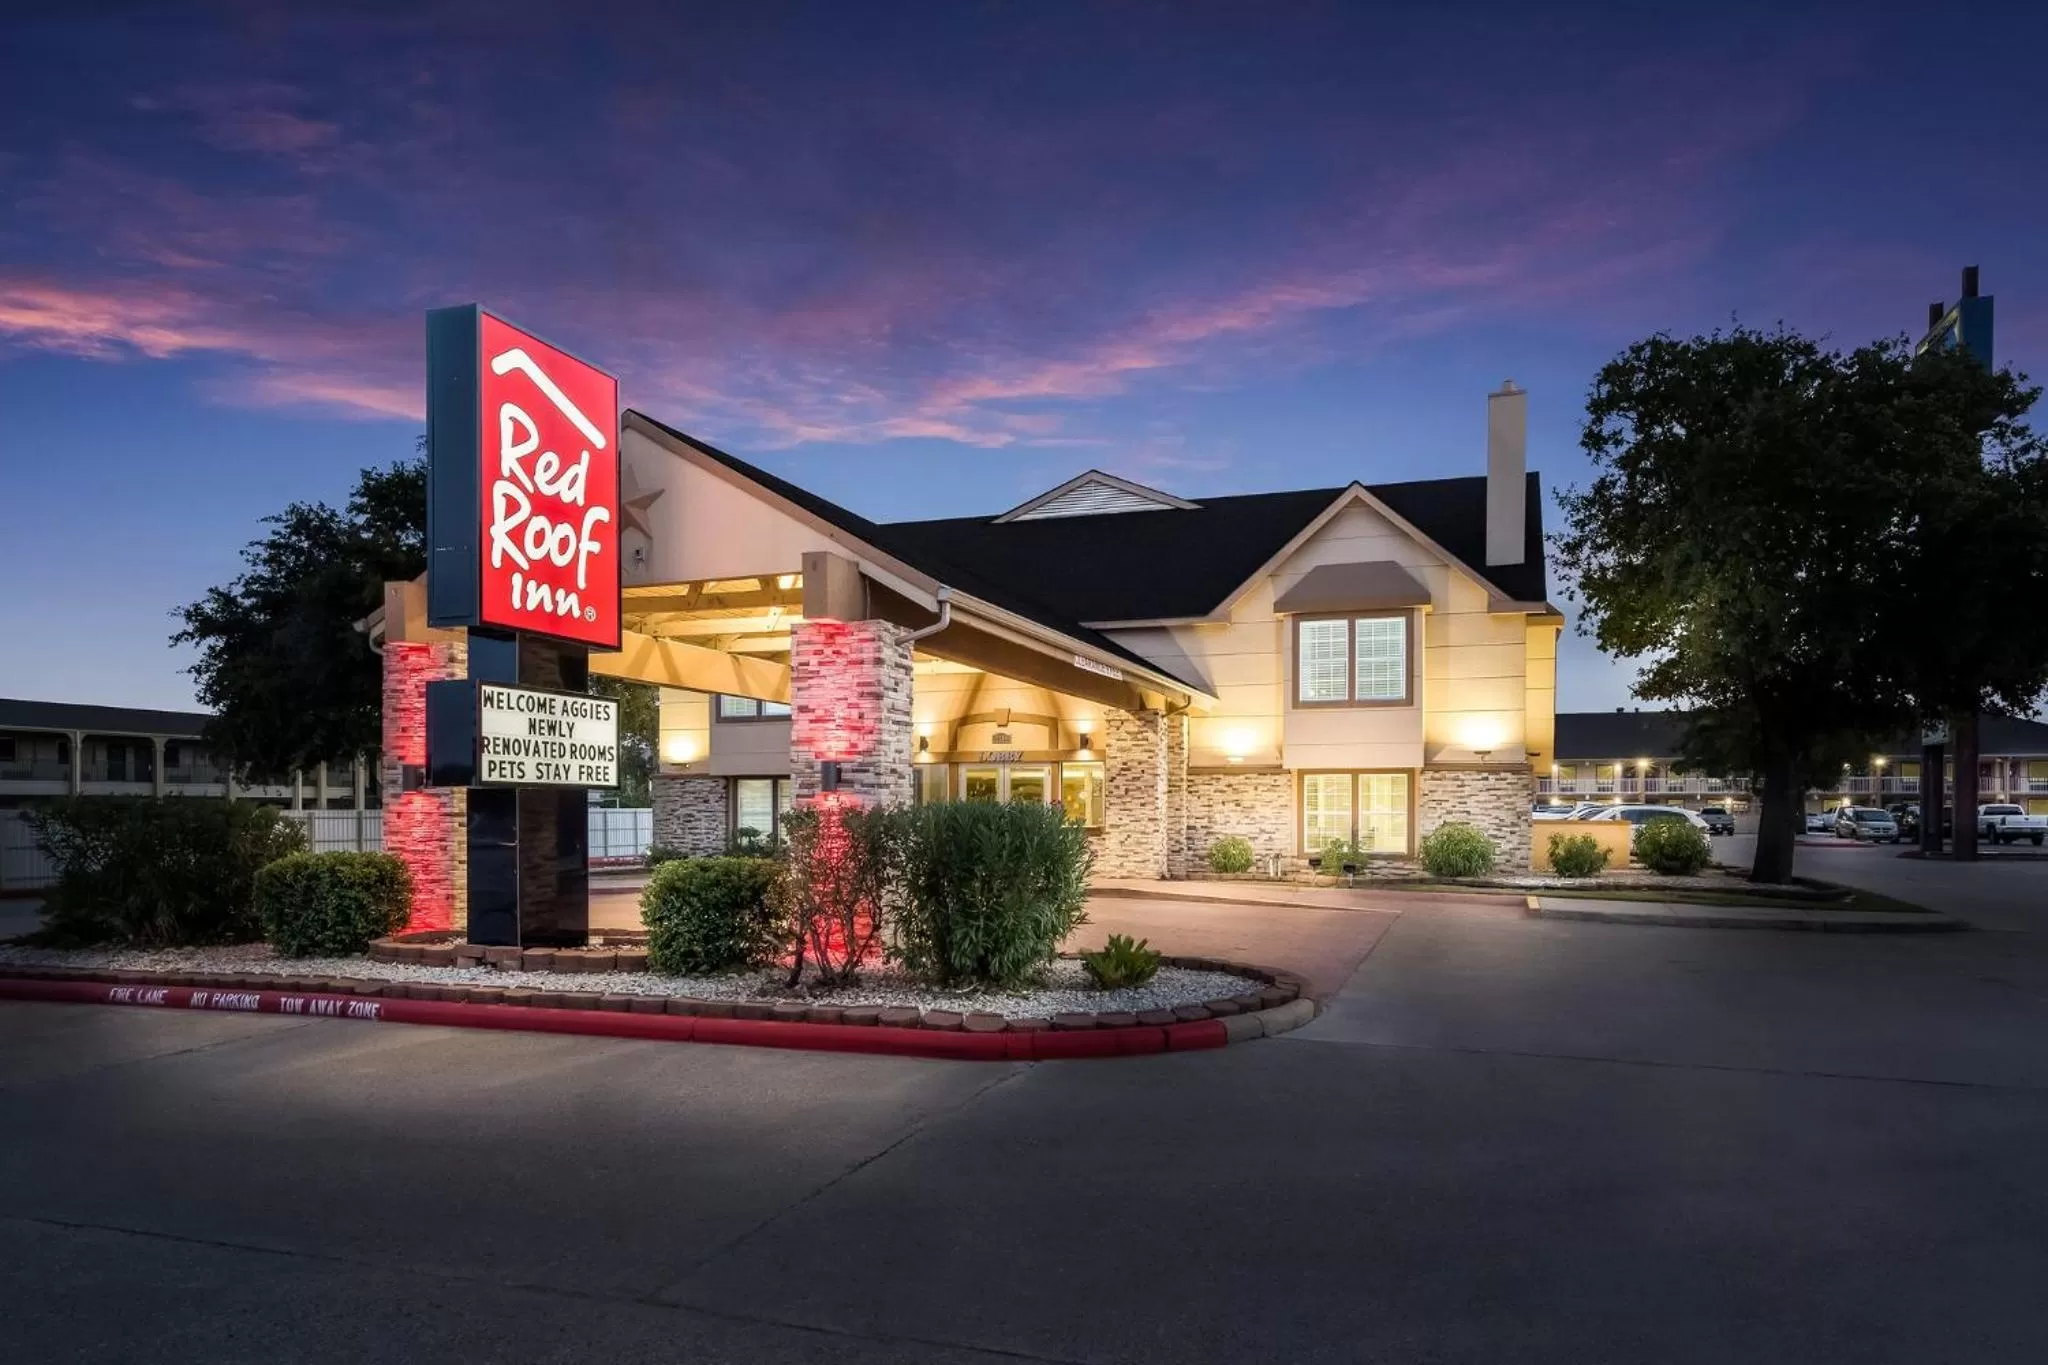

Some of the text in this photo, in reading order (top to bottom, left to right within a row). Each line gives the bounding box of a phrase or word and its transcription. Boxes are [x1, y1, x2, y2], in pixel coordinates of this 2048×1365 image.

[500, 403, 590, 506] Red
[490, 480, 610, 590] Roof
[483, 689, 611, 721] WELCOME AGGIES
[528, 717, 576, 739] NEWLY
[482, 736, 615, 762] RENOVATED ROOMS
[979, 751, 1024, 764] LOBBY
[488, 760, 610, 782] PETS STAY FREE
[109, 987, 382, 1019] FIRE LANE NO PARKING TOW AWAY ZONE
